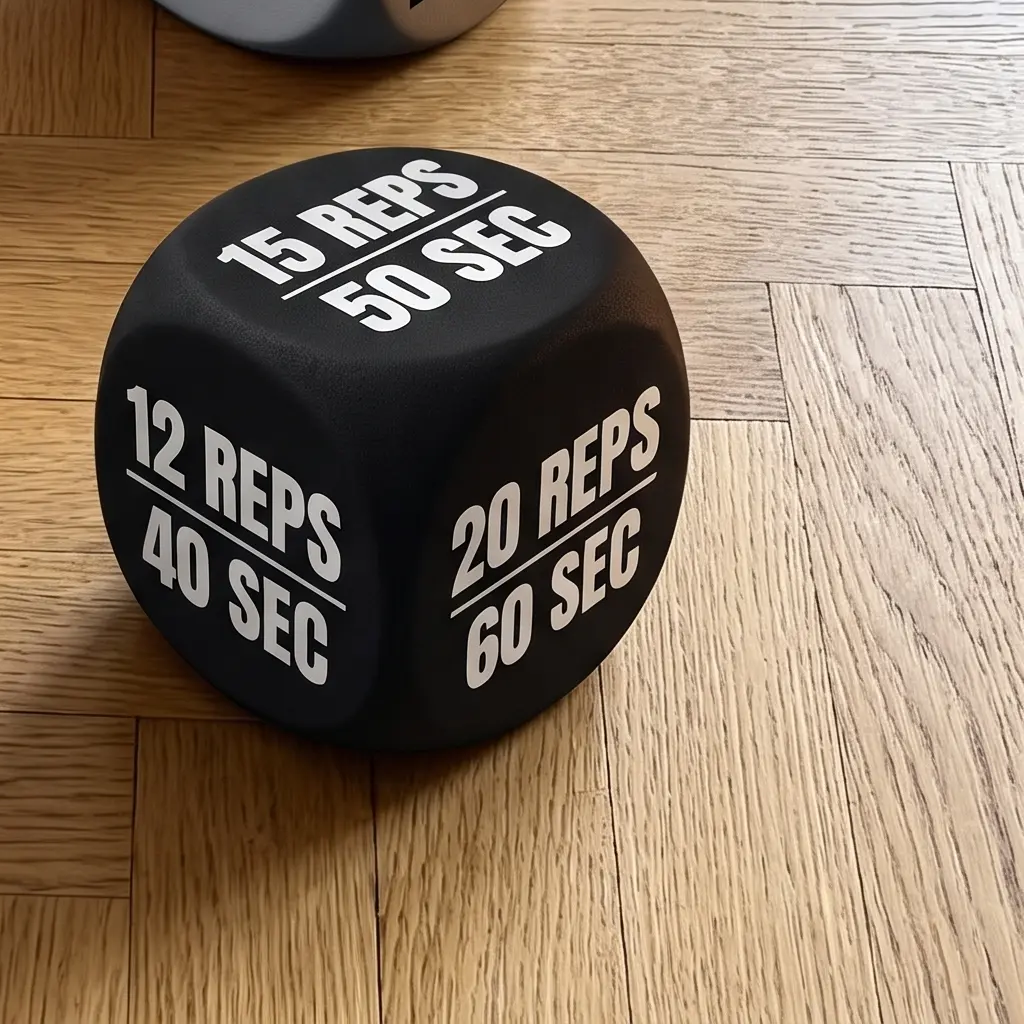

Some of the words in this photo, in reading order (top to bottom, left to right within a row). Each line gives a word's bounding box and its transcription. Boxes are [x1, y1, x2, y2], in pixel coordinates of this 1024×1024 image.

[216, 226, 326, 285] 15
[296, 158, 479, 248] REPS
[318, 264, 451, 333] 50
[421, 205, 571, 281] SEC
[126, 385, 185, 491] 12
[204, 425, 341, 583] REPS
[451, 481, 520, 598] 20
[537, 385, 661, 539] REPS
[142, 505, 210, 608] 40
[228, 558, 328, 685] SEC
[466, 583, 533, 689] 60
[550, 507, 641, 631] SEC
